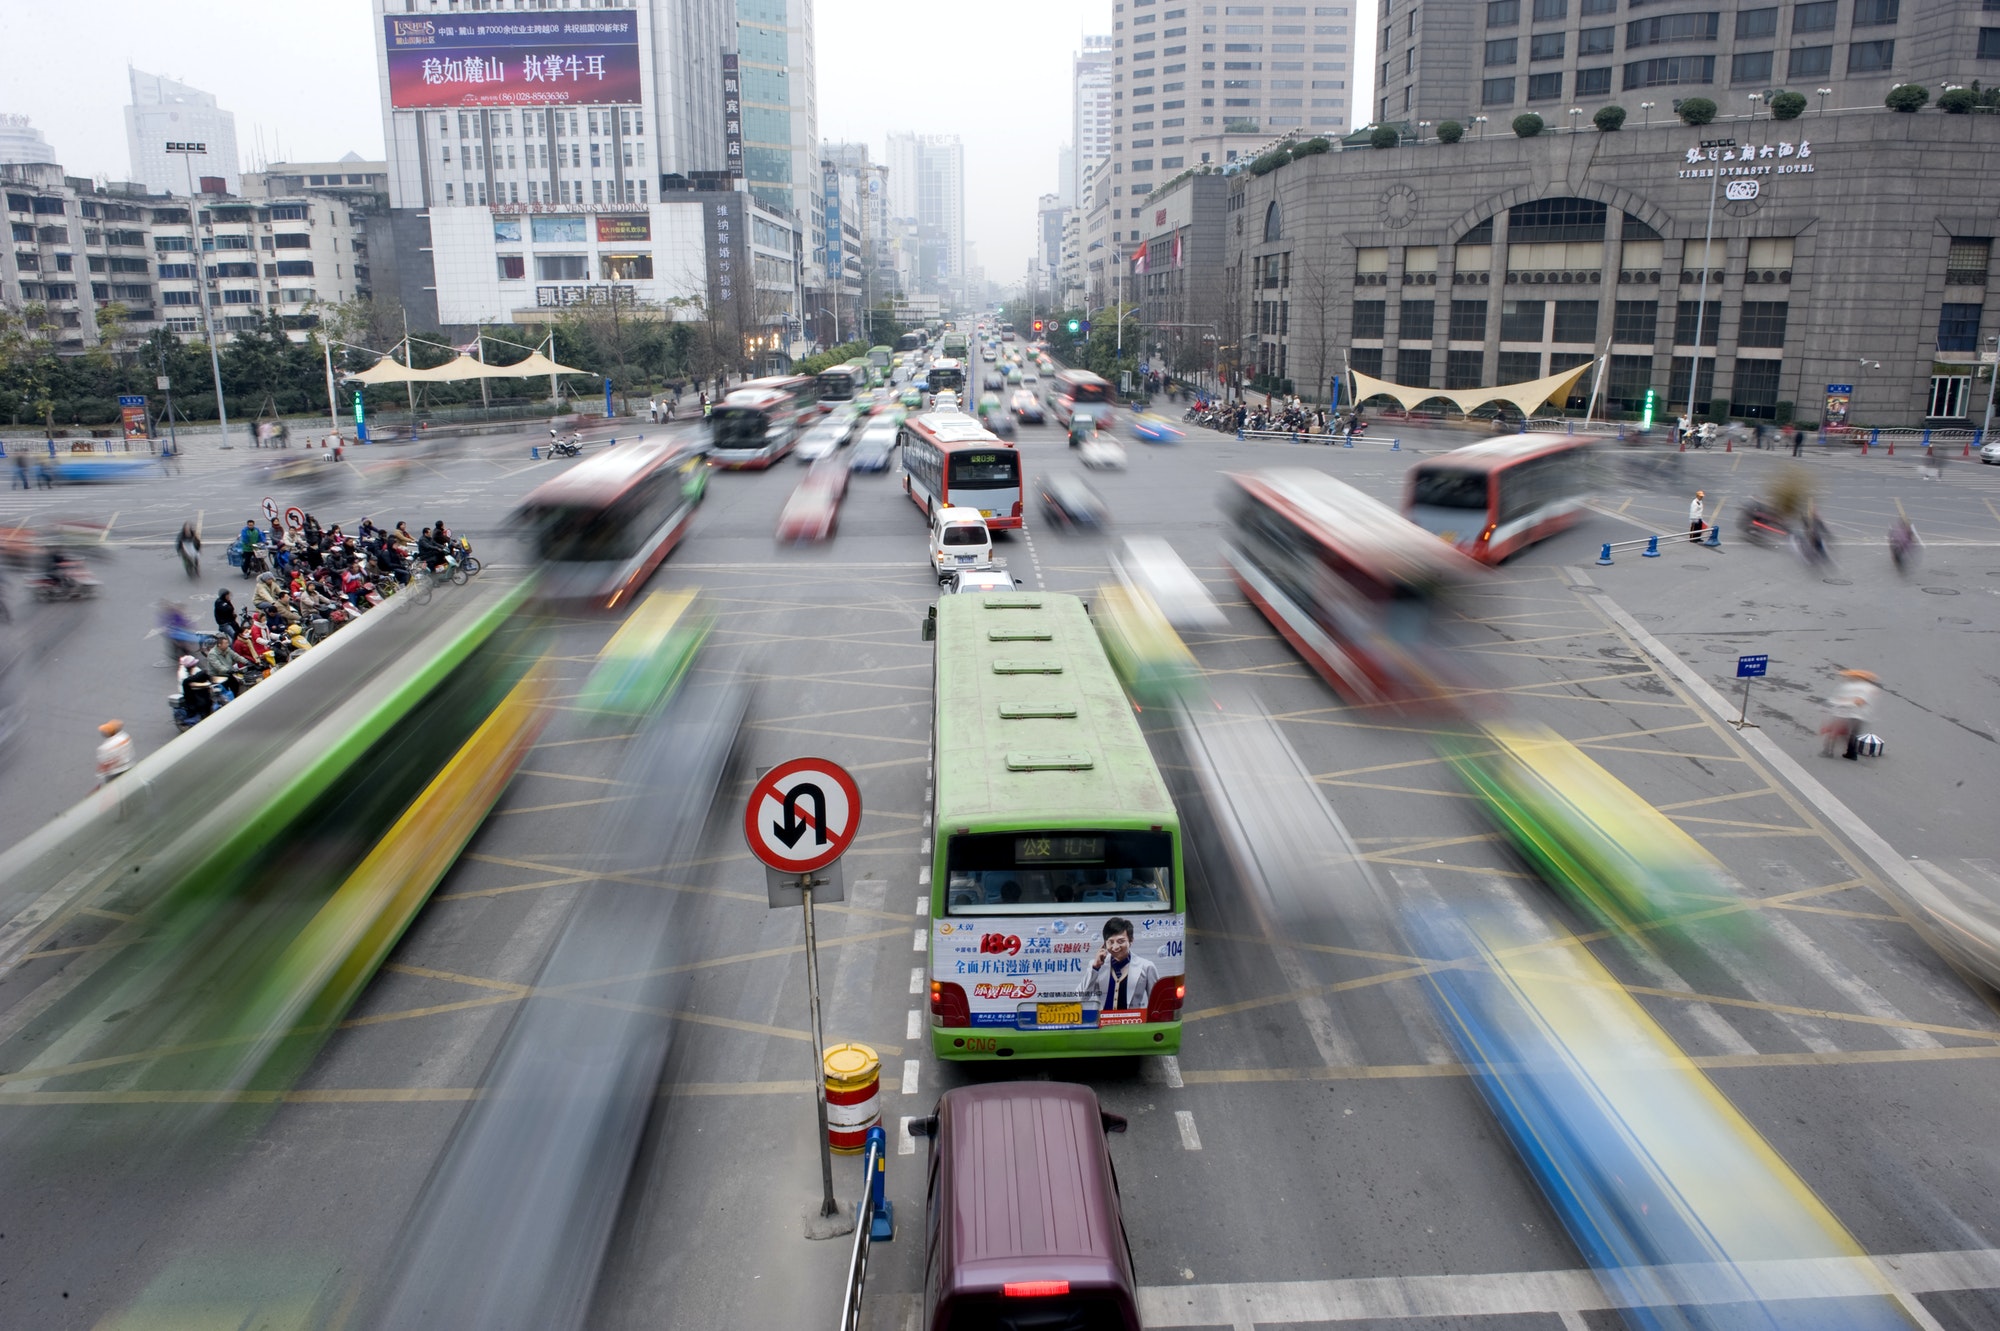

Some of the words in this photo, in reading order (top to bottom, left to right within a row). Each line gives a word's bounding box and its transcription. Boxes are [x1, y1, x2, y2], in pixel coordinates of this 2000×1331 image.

[564, 23, 628, 34] 共祝祖国09新年好
[422, 55, 504, 85] 稳如麓山
[523, 54, 606, 83] 执掌牛耳
[724, 78, 740, 155] 凯宾酒店
[1678, 168, 1714, 179] YINHE
[1719, 165, 1771, 176] DYNASTY
[1777, 163, 1815, 174] HOTEL
[489, 201, 558, 214] 维纳斯婚纱
[565, 203, 598, 212] VENUS
[601, 202, 649, 212] WEDDING
[717, 204, 731, 300] 维纳斯婚纱摄影
[539, 286, 633, 306] 凯宾酒店
[1023, 838, 1050, 856] 公交
[1064, 838, 1096, 855] 104
[980, 933, 1022, 956] 189
[1026, 937, 1051, 948] 天翼
[1053, 942, 1091, 954] 震撼放号
[1166, 940, 1182, 957] 104
[955, 957, 1082, 974] 全面开启漫游单向时代
[966, 1037, 997, 1052] CNG
